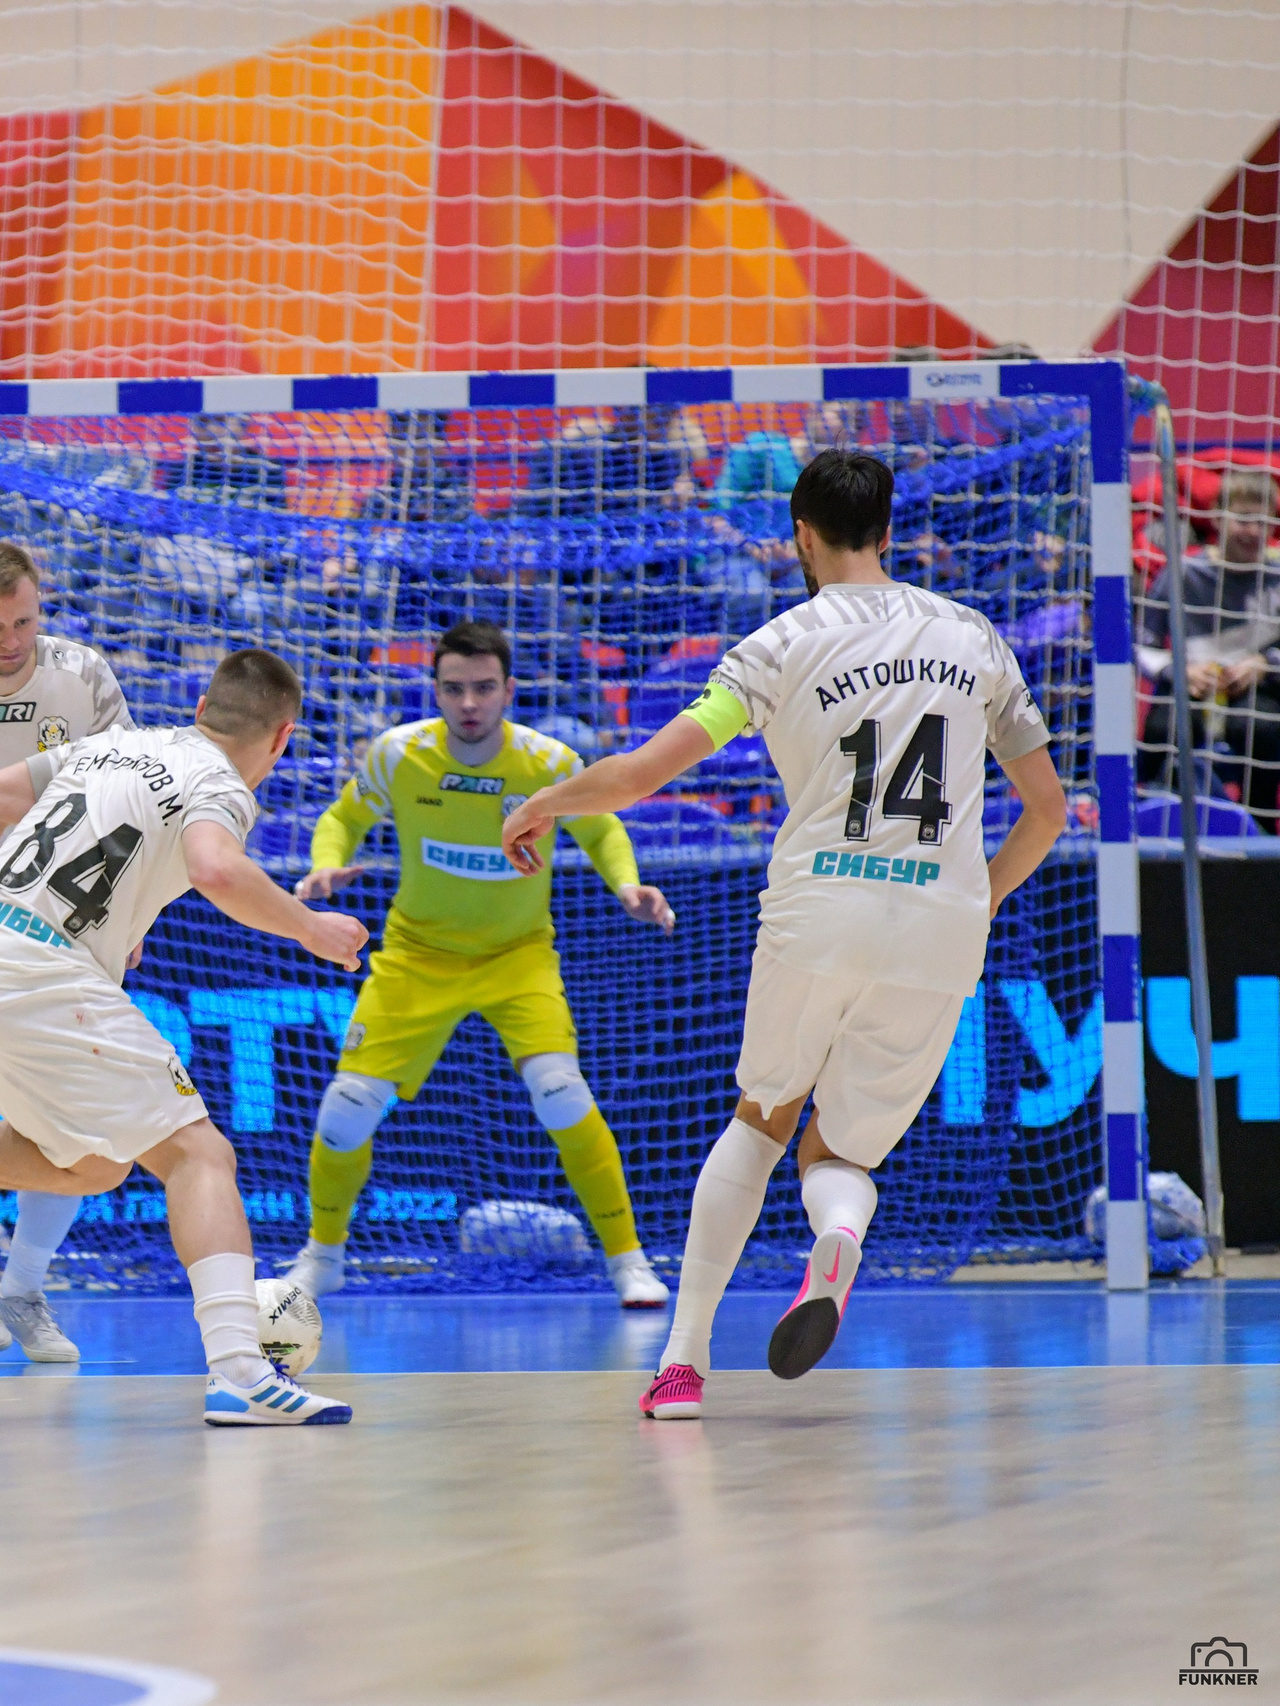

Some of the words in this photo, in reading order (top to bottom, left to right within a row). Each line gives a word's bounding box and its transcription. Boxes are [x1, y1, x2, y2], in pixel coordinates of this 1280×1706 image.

[815, 657, 977, 713] АНТОШКИН
[440, 773, 504, 794] PARI
[839, 713, 953, 847] 14
[427, 845, 516, 873] СИБУ
[811, 850, 941, 887] СИБУР
[268, 1286, 303, 1326] DEMIX
